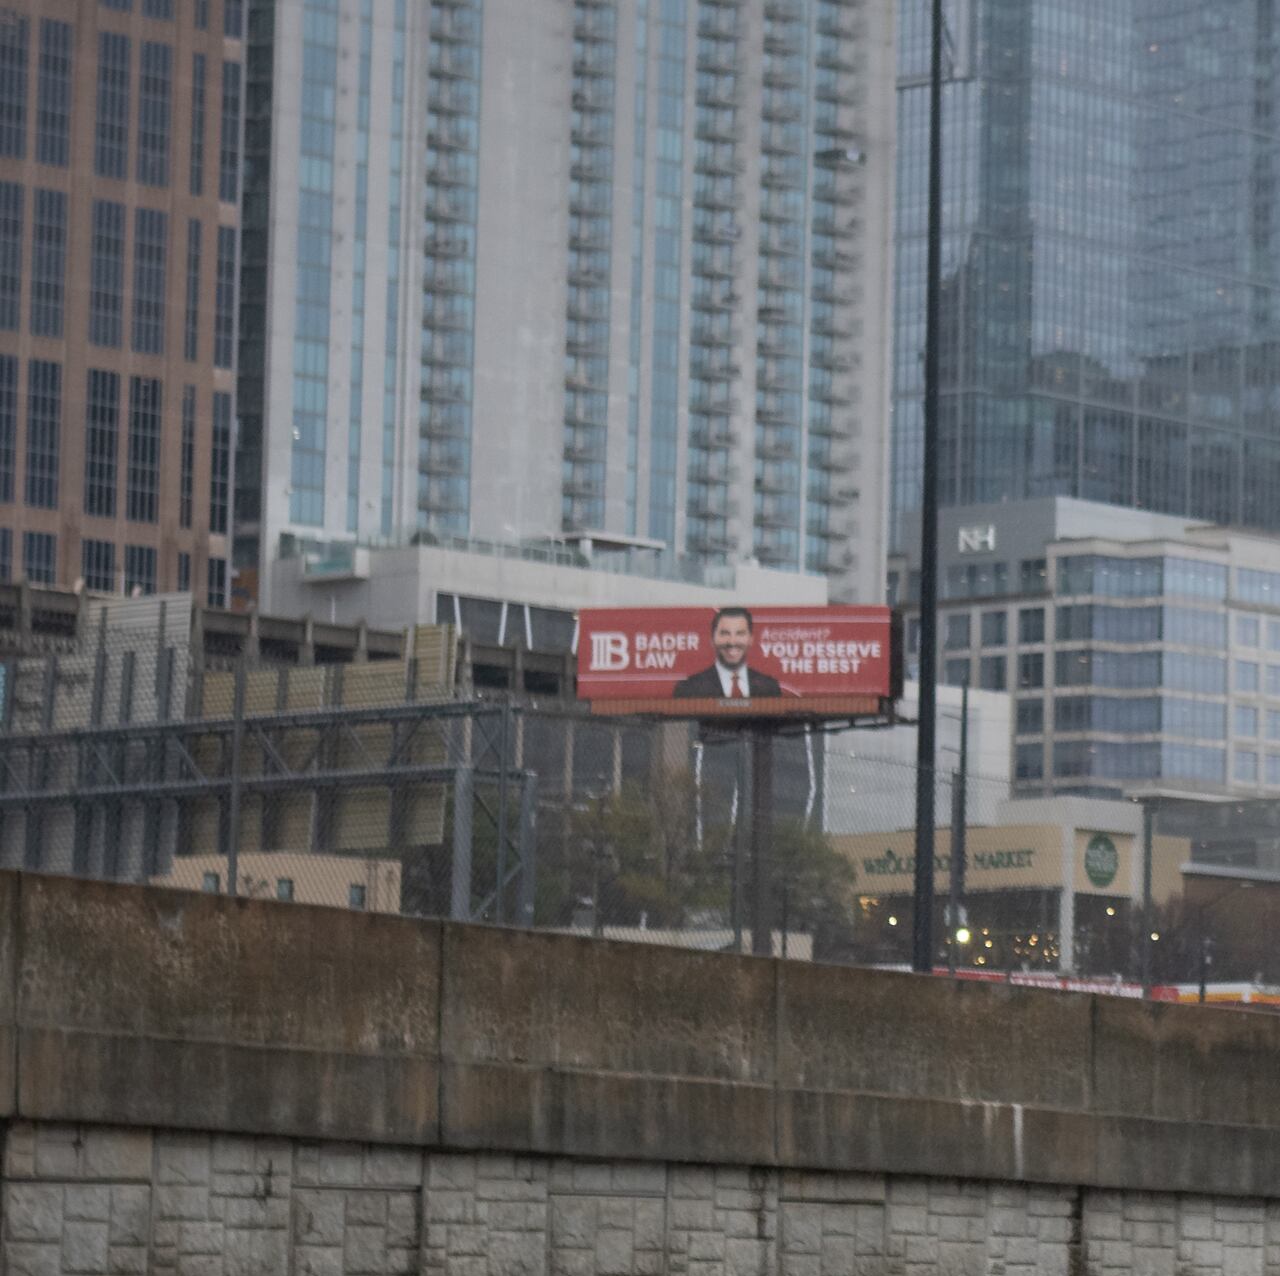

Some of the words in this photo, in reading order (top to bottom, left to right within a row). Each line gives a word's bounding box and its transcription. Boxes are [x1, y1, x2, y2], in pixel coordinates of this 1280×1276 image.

[959, 525, 995, 553] NH
[636, 631, 699, 651] BADER
[761, 627, 831, 640] Accident?
[760, 641, 799, 657] YOU
[803, 641, 880, 657] DESERVE
[635, 651, 676, 669] LAW
[780, 658, 813, 673] THE
[817, 658, 860, 673] BEST
[974, 850, 1033, 870] MARKET
